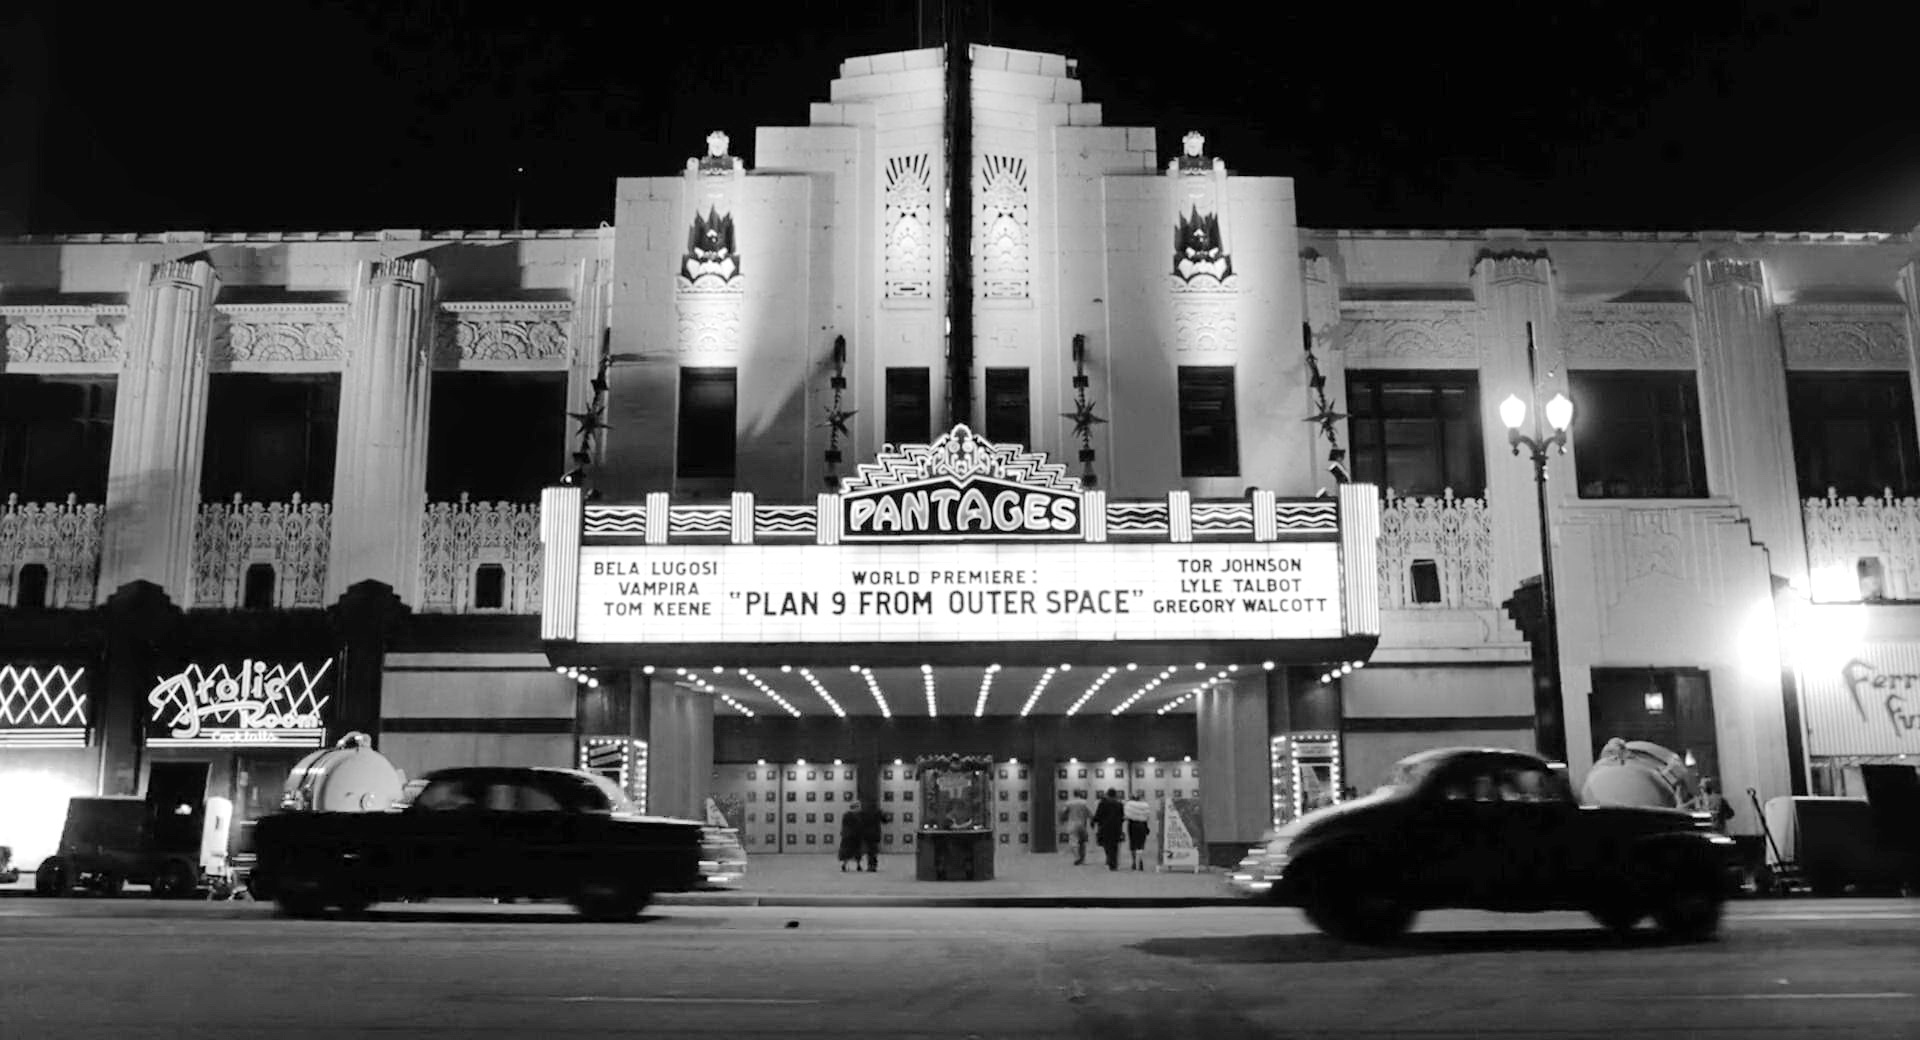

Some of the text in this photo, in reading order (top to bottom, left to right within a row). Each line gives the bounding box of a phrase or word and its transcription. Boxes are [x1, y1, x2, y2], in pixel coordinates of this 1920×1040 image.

[849, 487, 1077, 532] PANTAGES
[594, 561, 717, 576] BELA LUGOSI
[1178, 558, 1301, 573] TOR JOHNSON
[852, 570, 1036, 585] WORLD PREMIERE:
[619, 582, 698, 595] VAMPIRA
[1181, 578, 1299, 593] LYLE TALBOT
[604, 602, 710, 616] TOM KEENE
[730, 589, 1143, 616] "PLAN 9 FROM OUTER SPACE"
[1153, 598, 1327, 613] GREGORY WALCOTT
[1842, 659, 1920, 722] Ferr
[239, 701, 319, 728] Room
[1885, 694, 1920, 738] Fu
